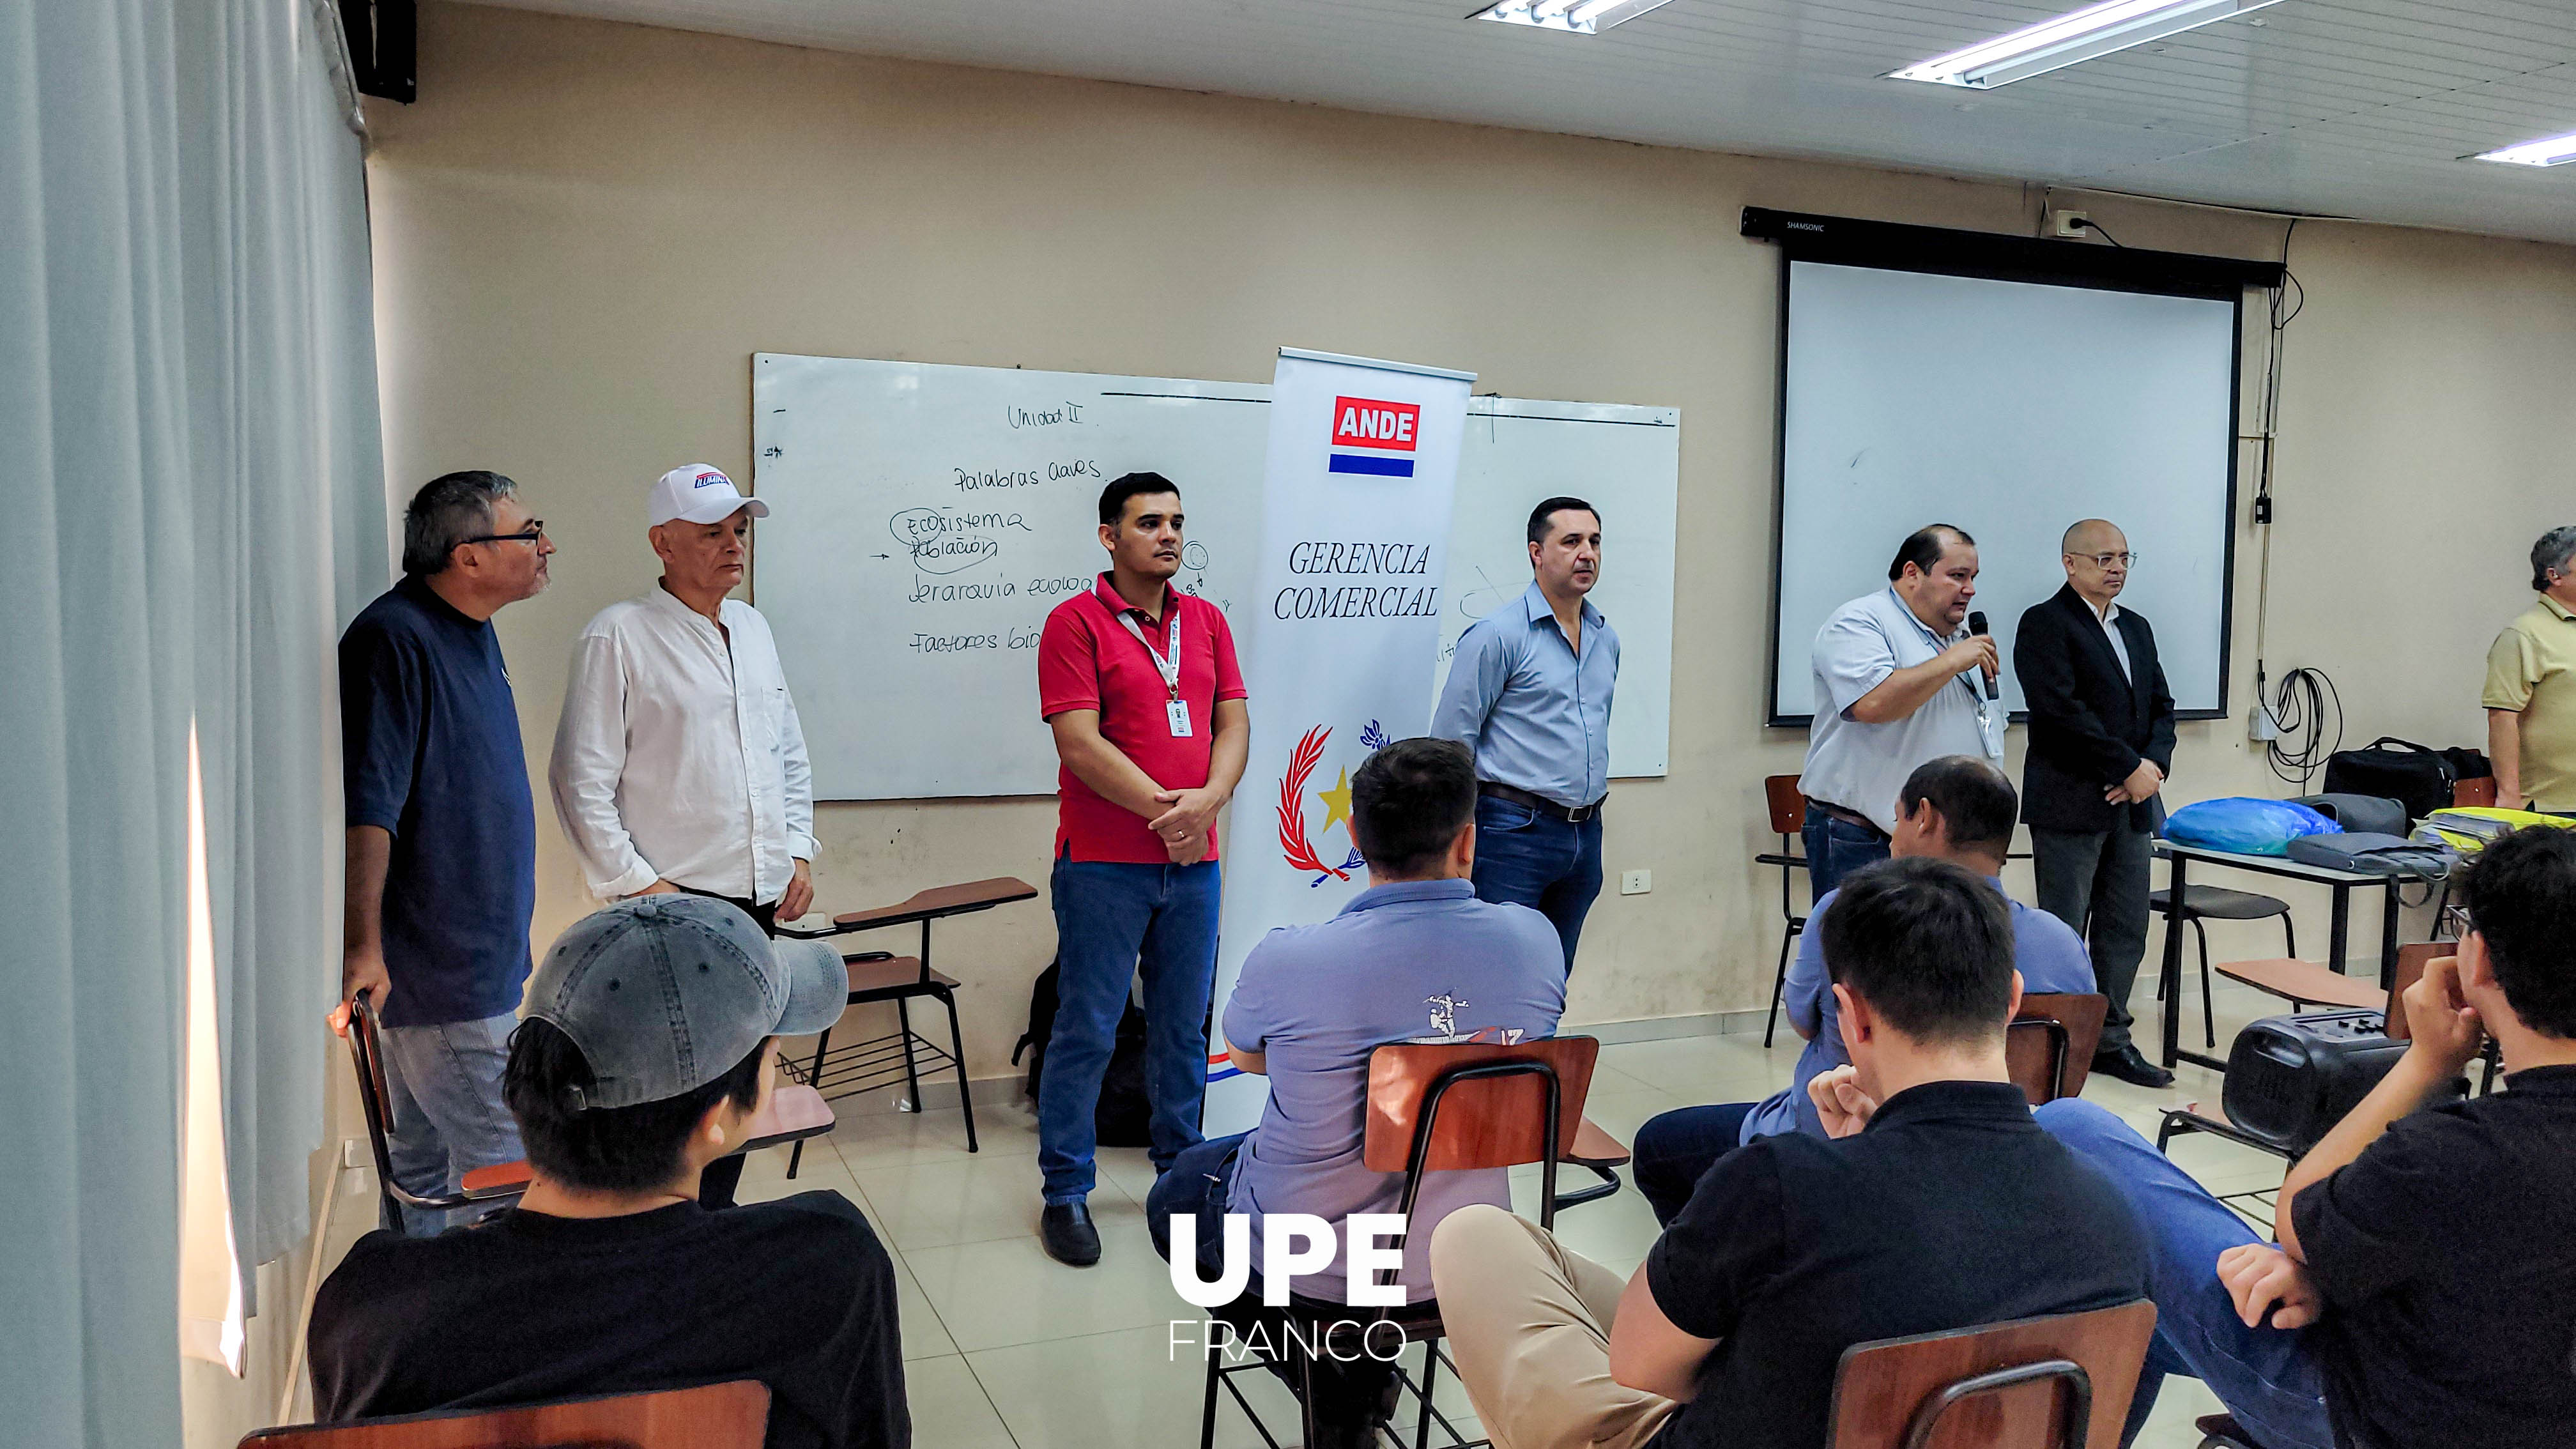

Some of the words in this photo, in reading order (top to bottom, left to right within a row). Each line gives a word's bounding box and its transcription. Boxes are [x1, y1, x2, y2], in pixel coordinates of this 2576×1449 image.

[1787, 221, 1825, 232] SHAMSONIC
[1338, 406, 1414, 442] ANDE
[1289, 542, 1430, 574] GERENCIA
[1274, 586, 1439, 620] COMERCIAL
